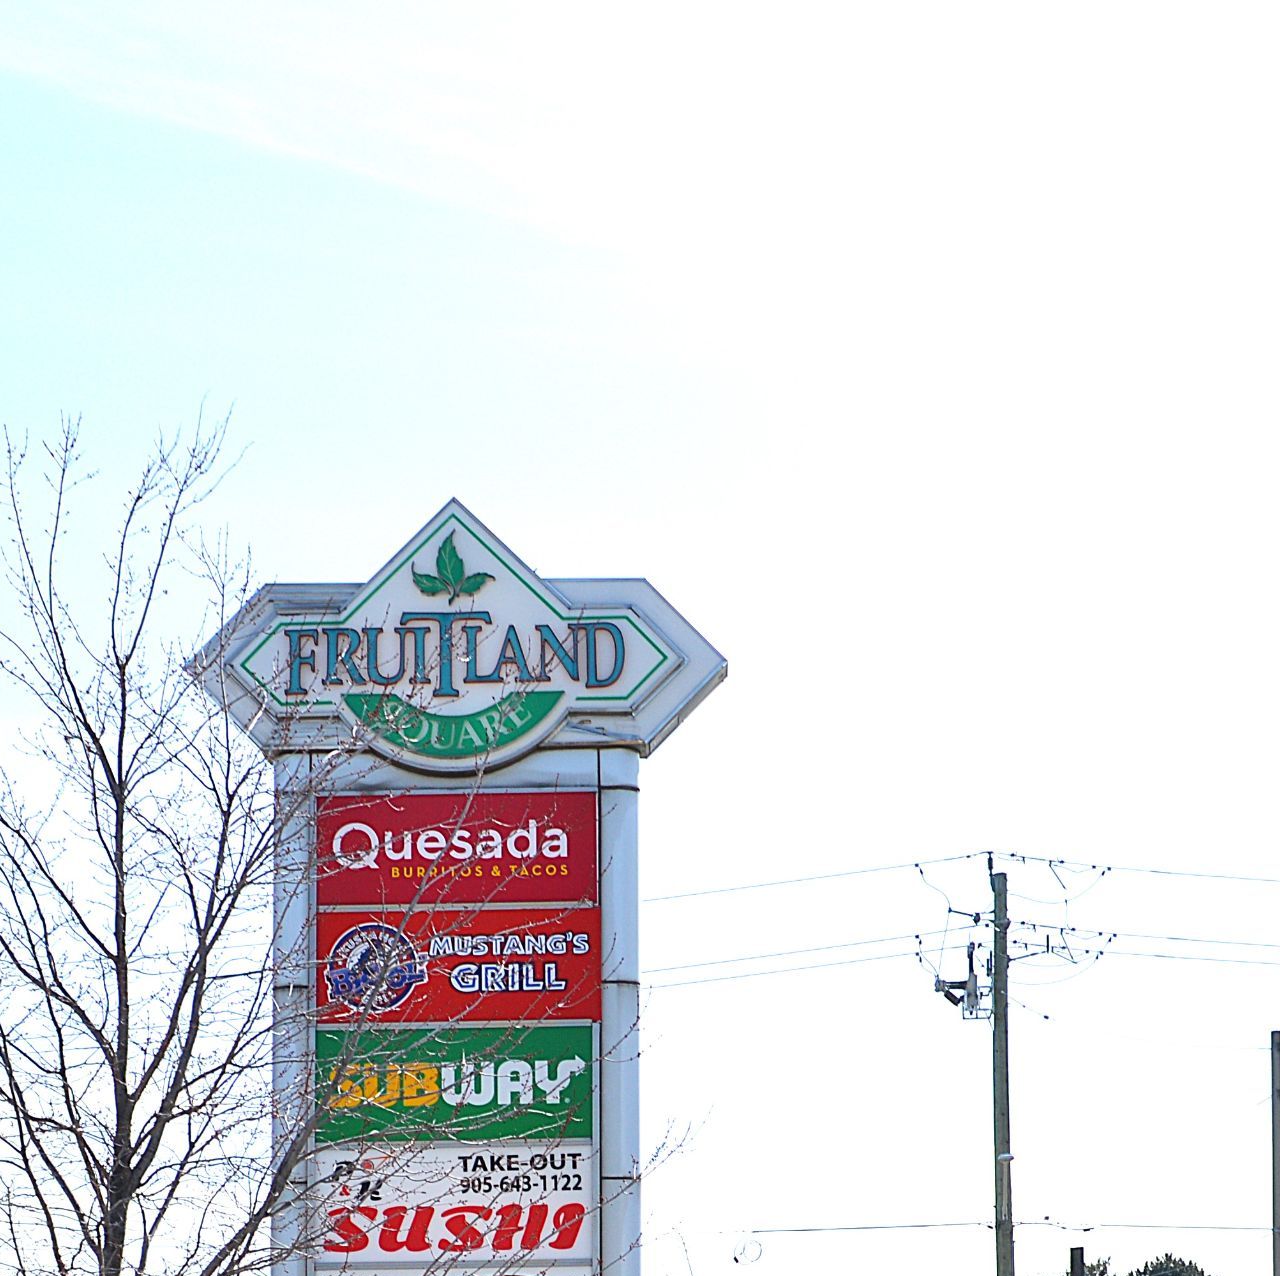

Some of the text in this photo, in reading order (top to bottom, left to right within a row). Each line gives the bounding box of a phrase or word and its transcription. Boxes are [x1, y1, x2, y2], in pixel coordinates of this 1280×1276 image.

[284, 611, 625, 697] FRUITLAND
[332, 819, 568, 869] Quesada
[391, 864, 569, 878] BURRITOS & TACOS
[337, 931, 408, 959] MUSTAN
[429, 932, 590, 956] MUSTANG'S
[450, 962, 567, 992] GRILL
[329, 1055, 587, 1109] SUBWAY
[458, 1153, 583, 1173] TAKE-OUT
[460, 1174, 583, 1194] 905-643-1122
